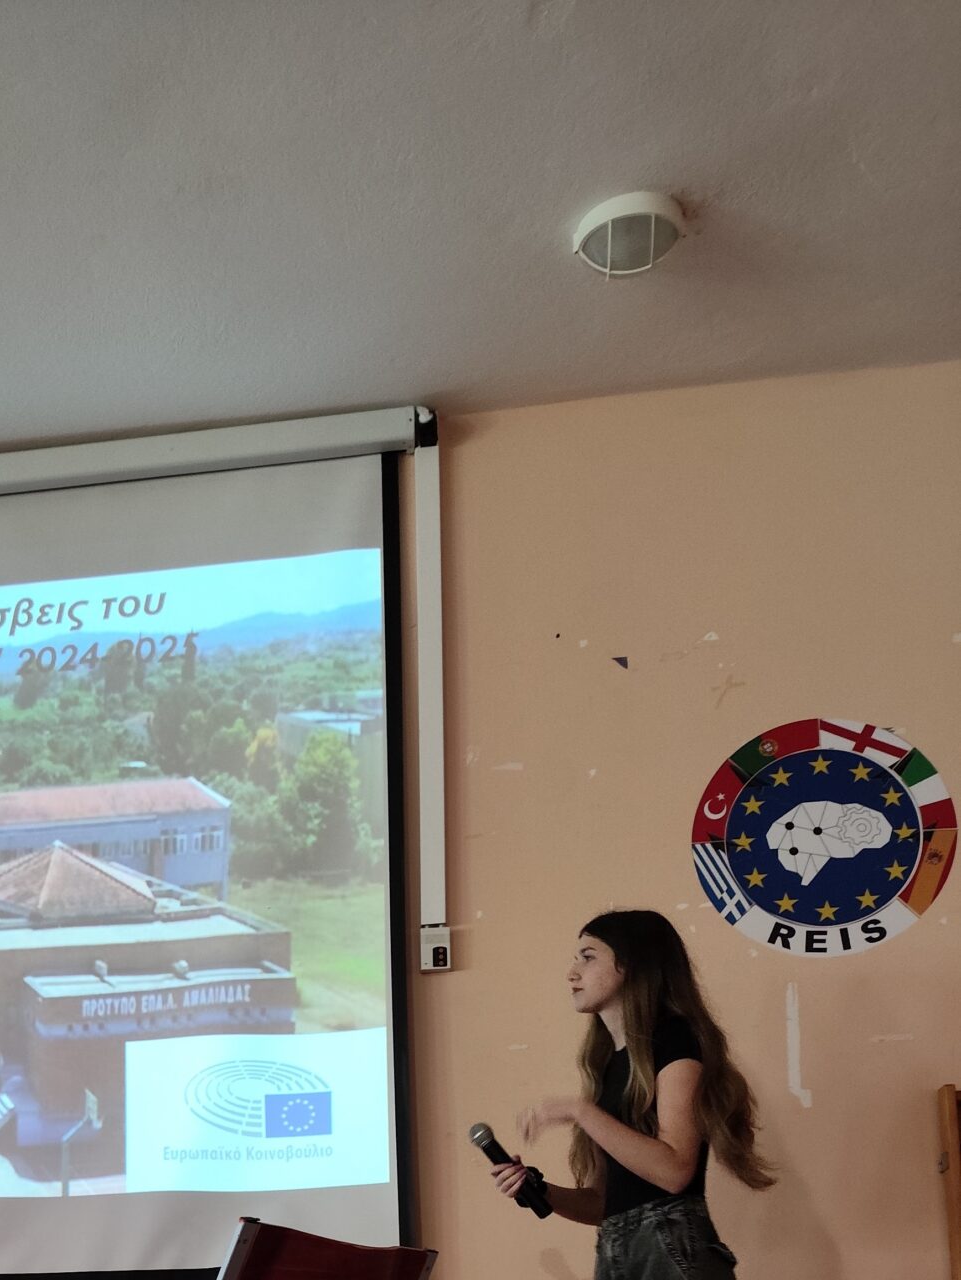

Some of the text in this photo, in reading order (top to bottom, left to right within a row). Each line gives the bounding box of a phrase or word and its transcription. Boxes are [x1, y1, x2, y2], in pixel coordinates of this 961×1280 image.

[101, 591, 167, 620] του
[767, 918, 887, 953] REIS
[163, 1144, 333, 1163] Ευρωπαϊκό Κοινοβούλιο
